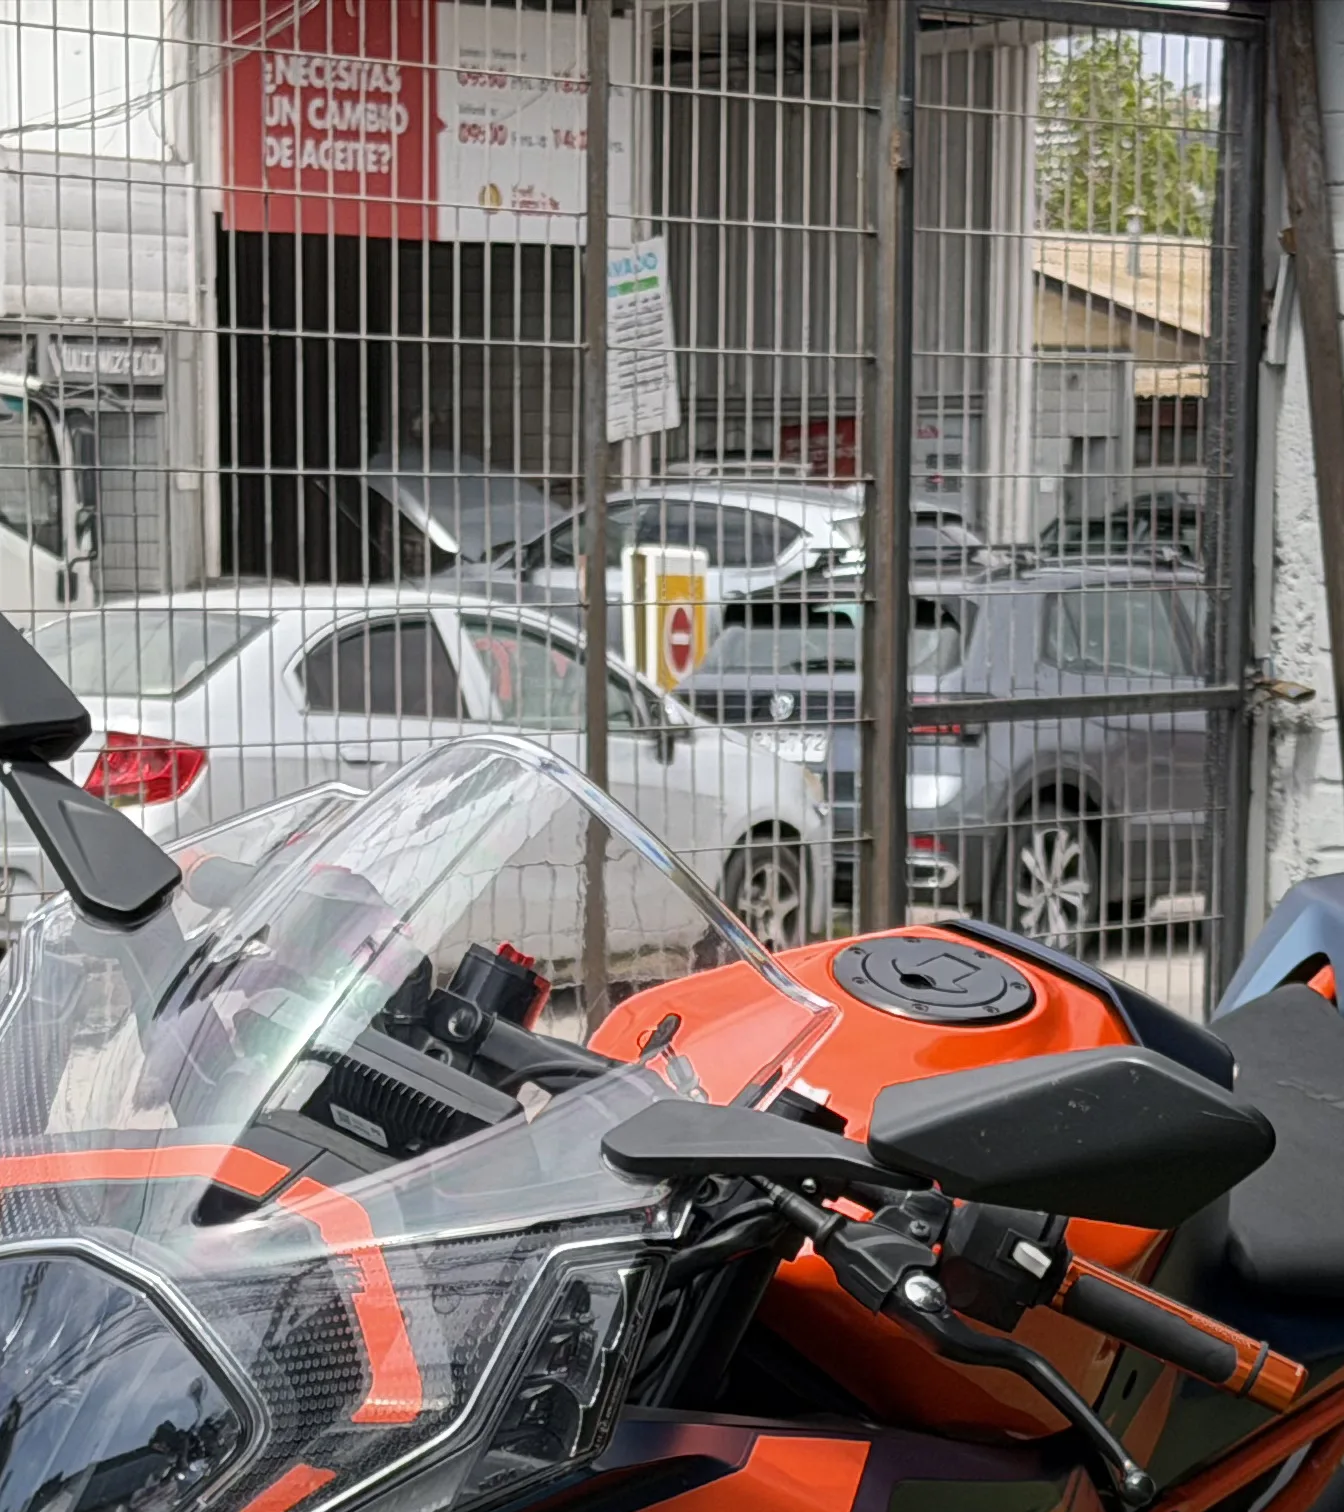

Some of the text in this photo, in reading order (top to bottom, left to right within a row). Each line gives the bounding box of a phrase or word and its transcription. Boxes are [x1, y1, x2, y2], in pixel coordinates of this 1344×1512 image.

[264, 55, 402, 93] ¿NECESITAS
[264, 96, 409, 134] UN CAMBIO
[265, 136, 392, 174] DE ACEITE?
